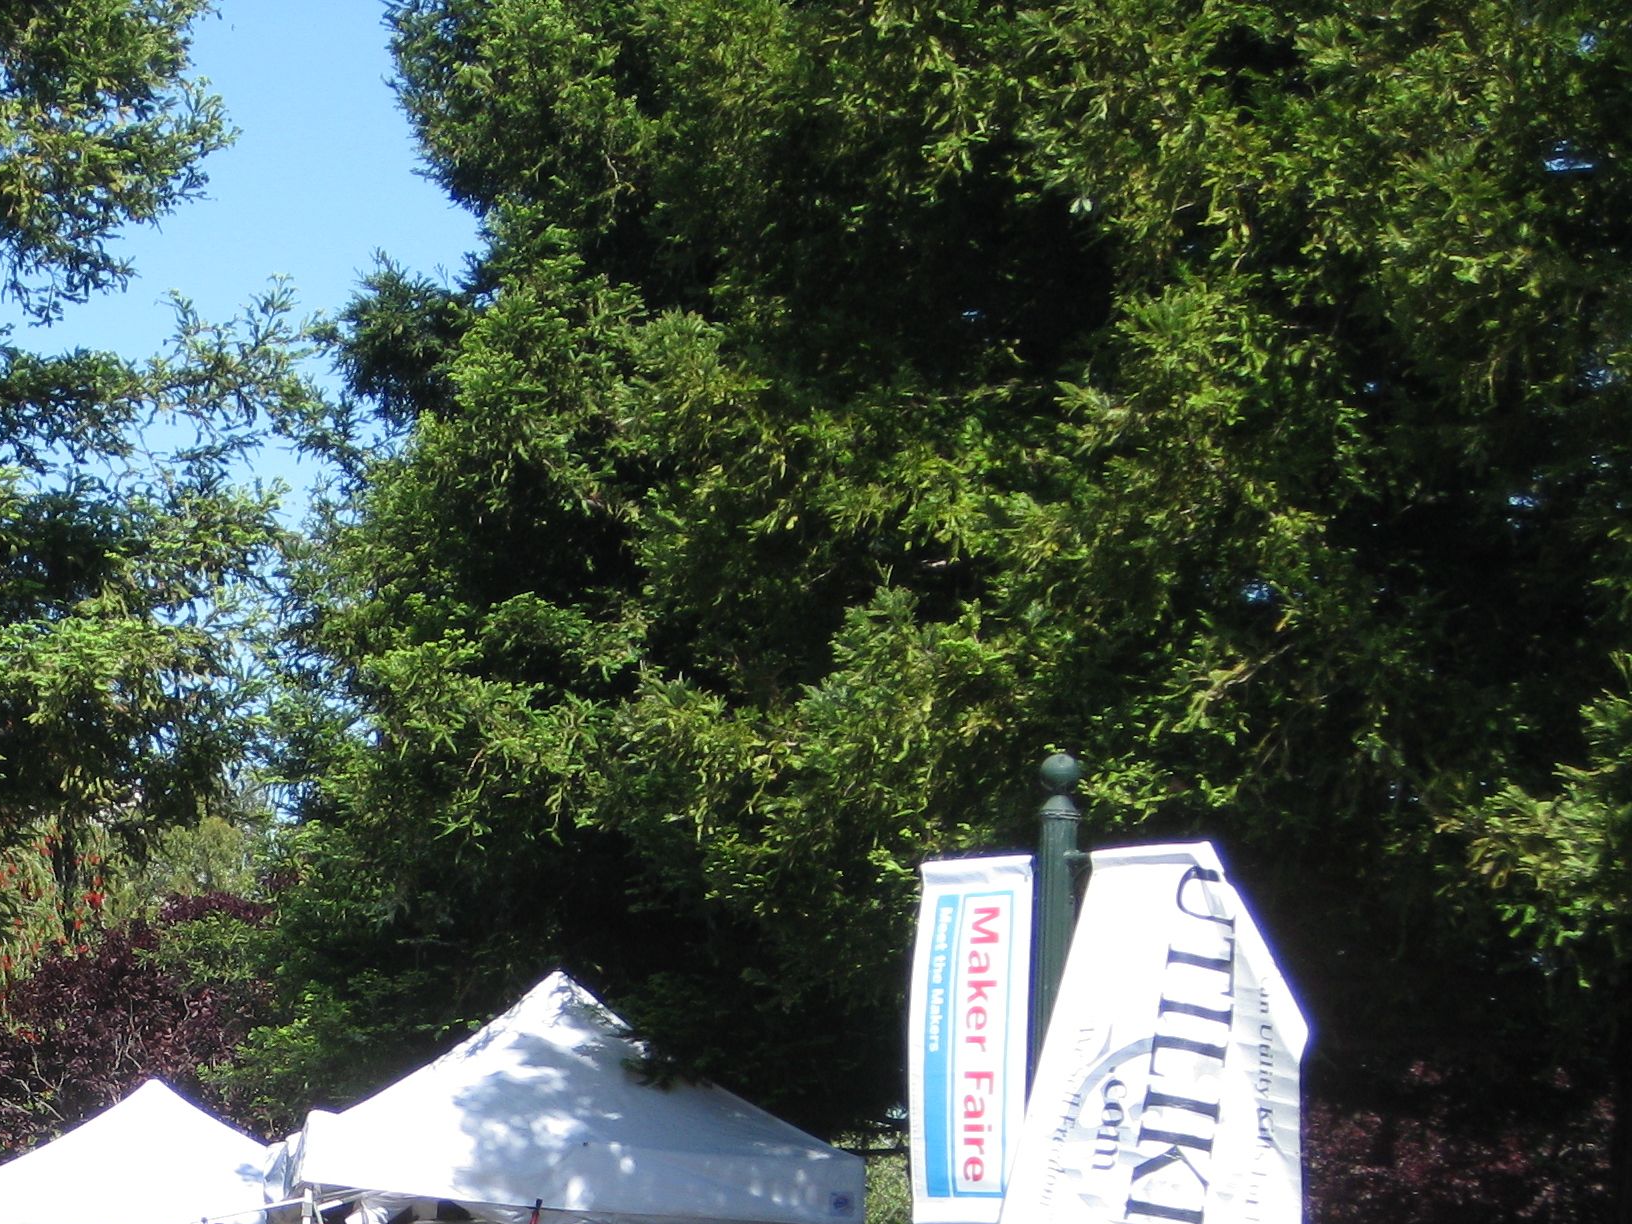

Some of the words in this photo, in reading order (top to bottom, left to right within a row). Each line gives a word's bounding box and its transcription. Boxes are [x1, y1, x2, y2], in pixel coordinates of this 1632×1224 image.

[935, 907, 953, 951] Meet
[932, 955, 946, 984] the
[965, 907, 1000, 1053] Maker
[929, 989, 944, 1052] Makers
[1255, 1024, 1274, 1100] Utility
[964, 1072, 994, 1182] Faire
